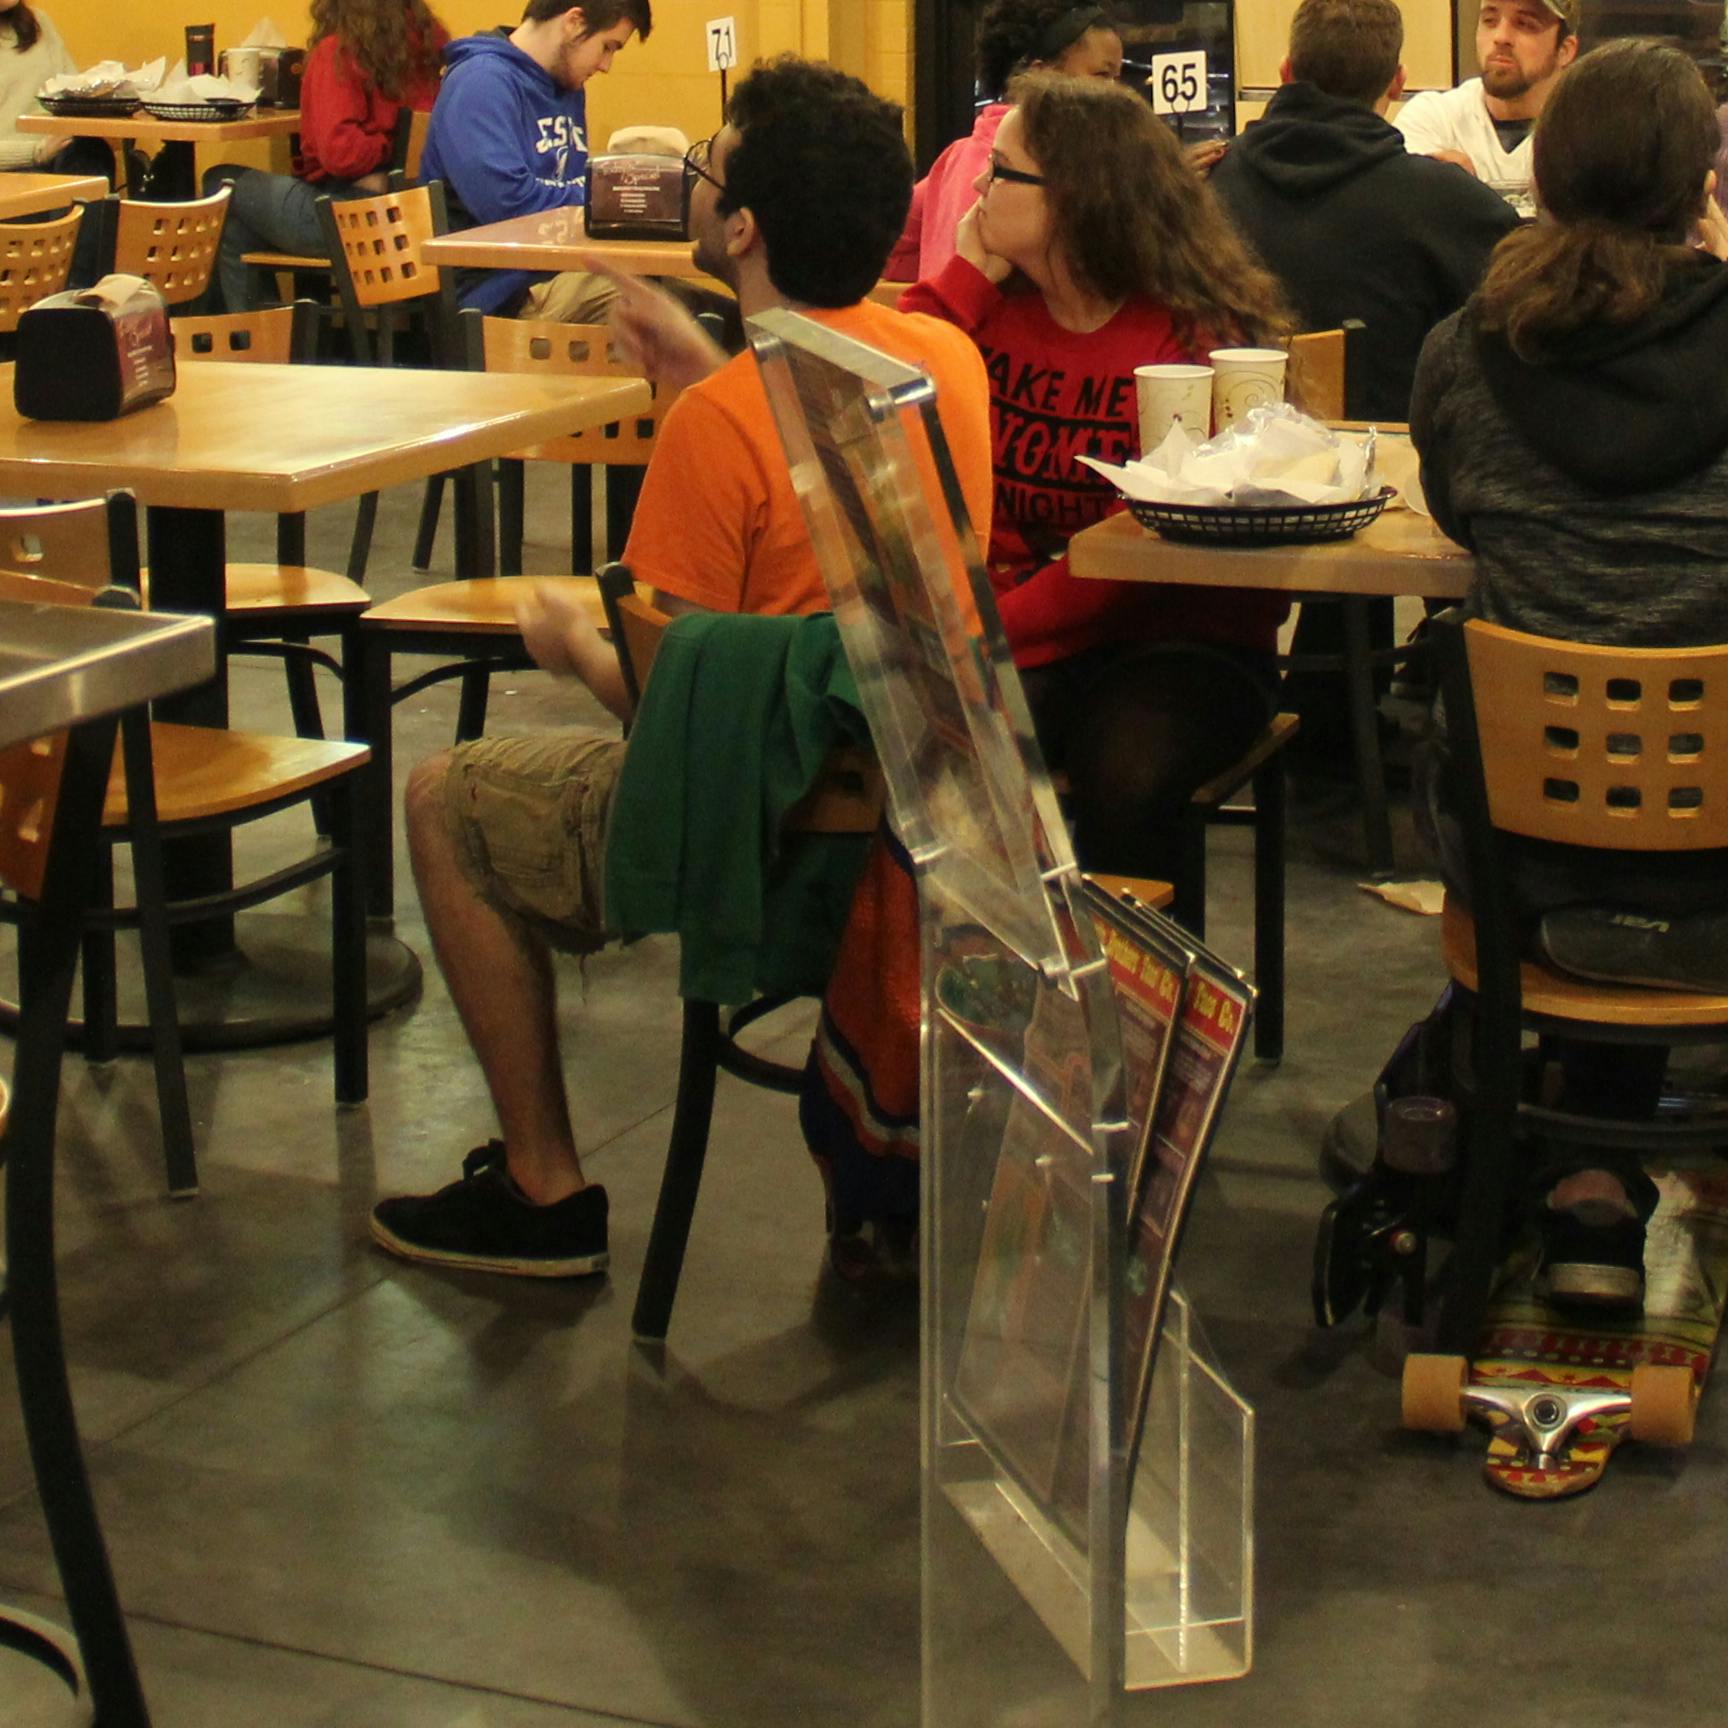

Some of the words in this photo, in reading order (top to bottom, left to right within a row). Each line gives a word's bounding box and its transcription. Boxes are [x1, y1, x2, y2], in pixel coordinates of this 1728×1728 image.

[712, 29, 733, 61] 71
[1161, 63, 1199, 103] 65
[1074, 374, 1135, 418] ME
